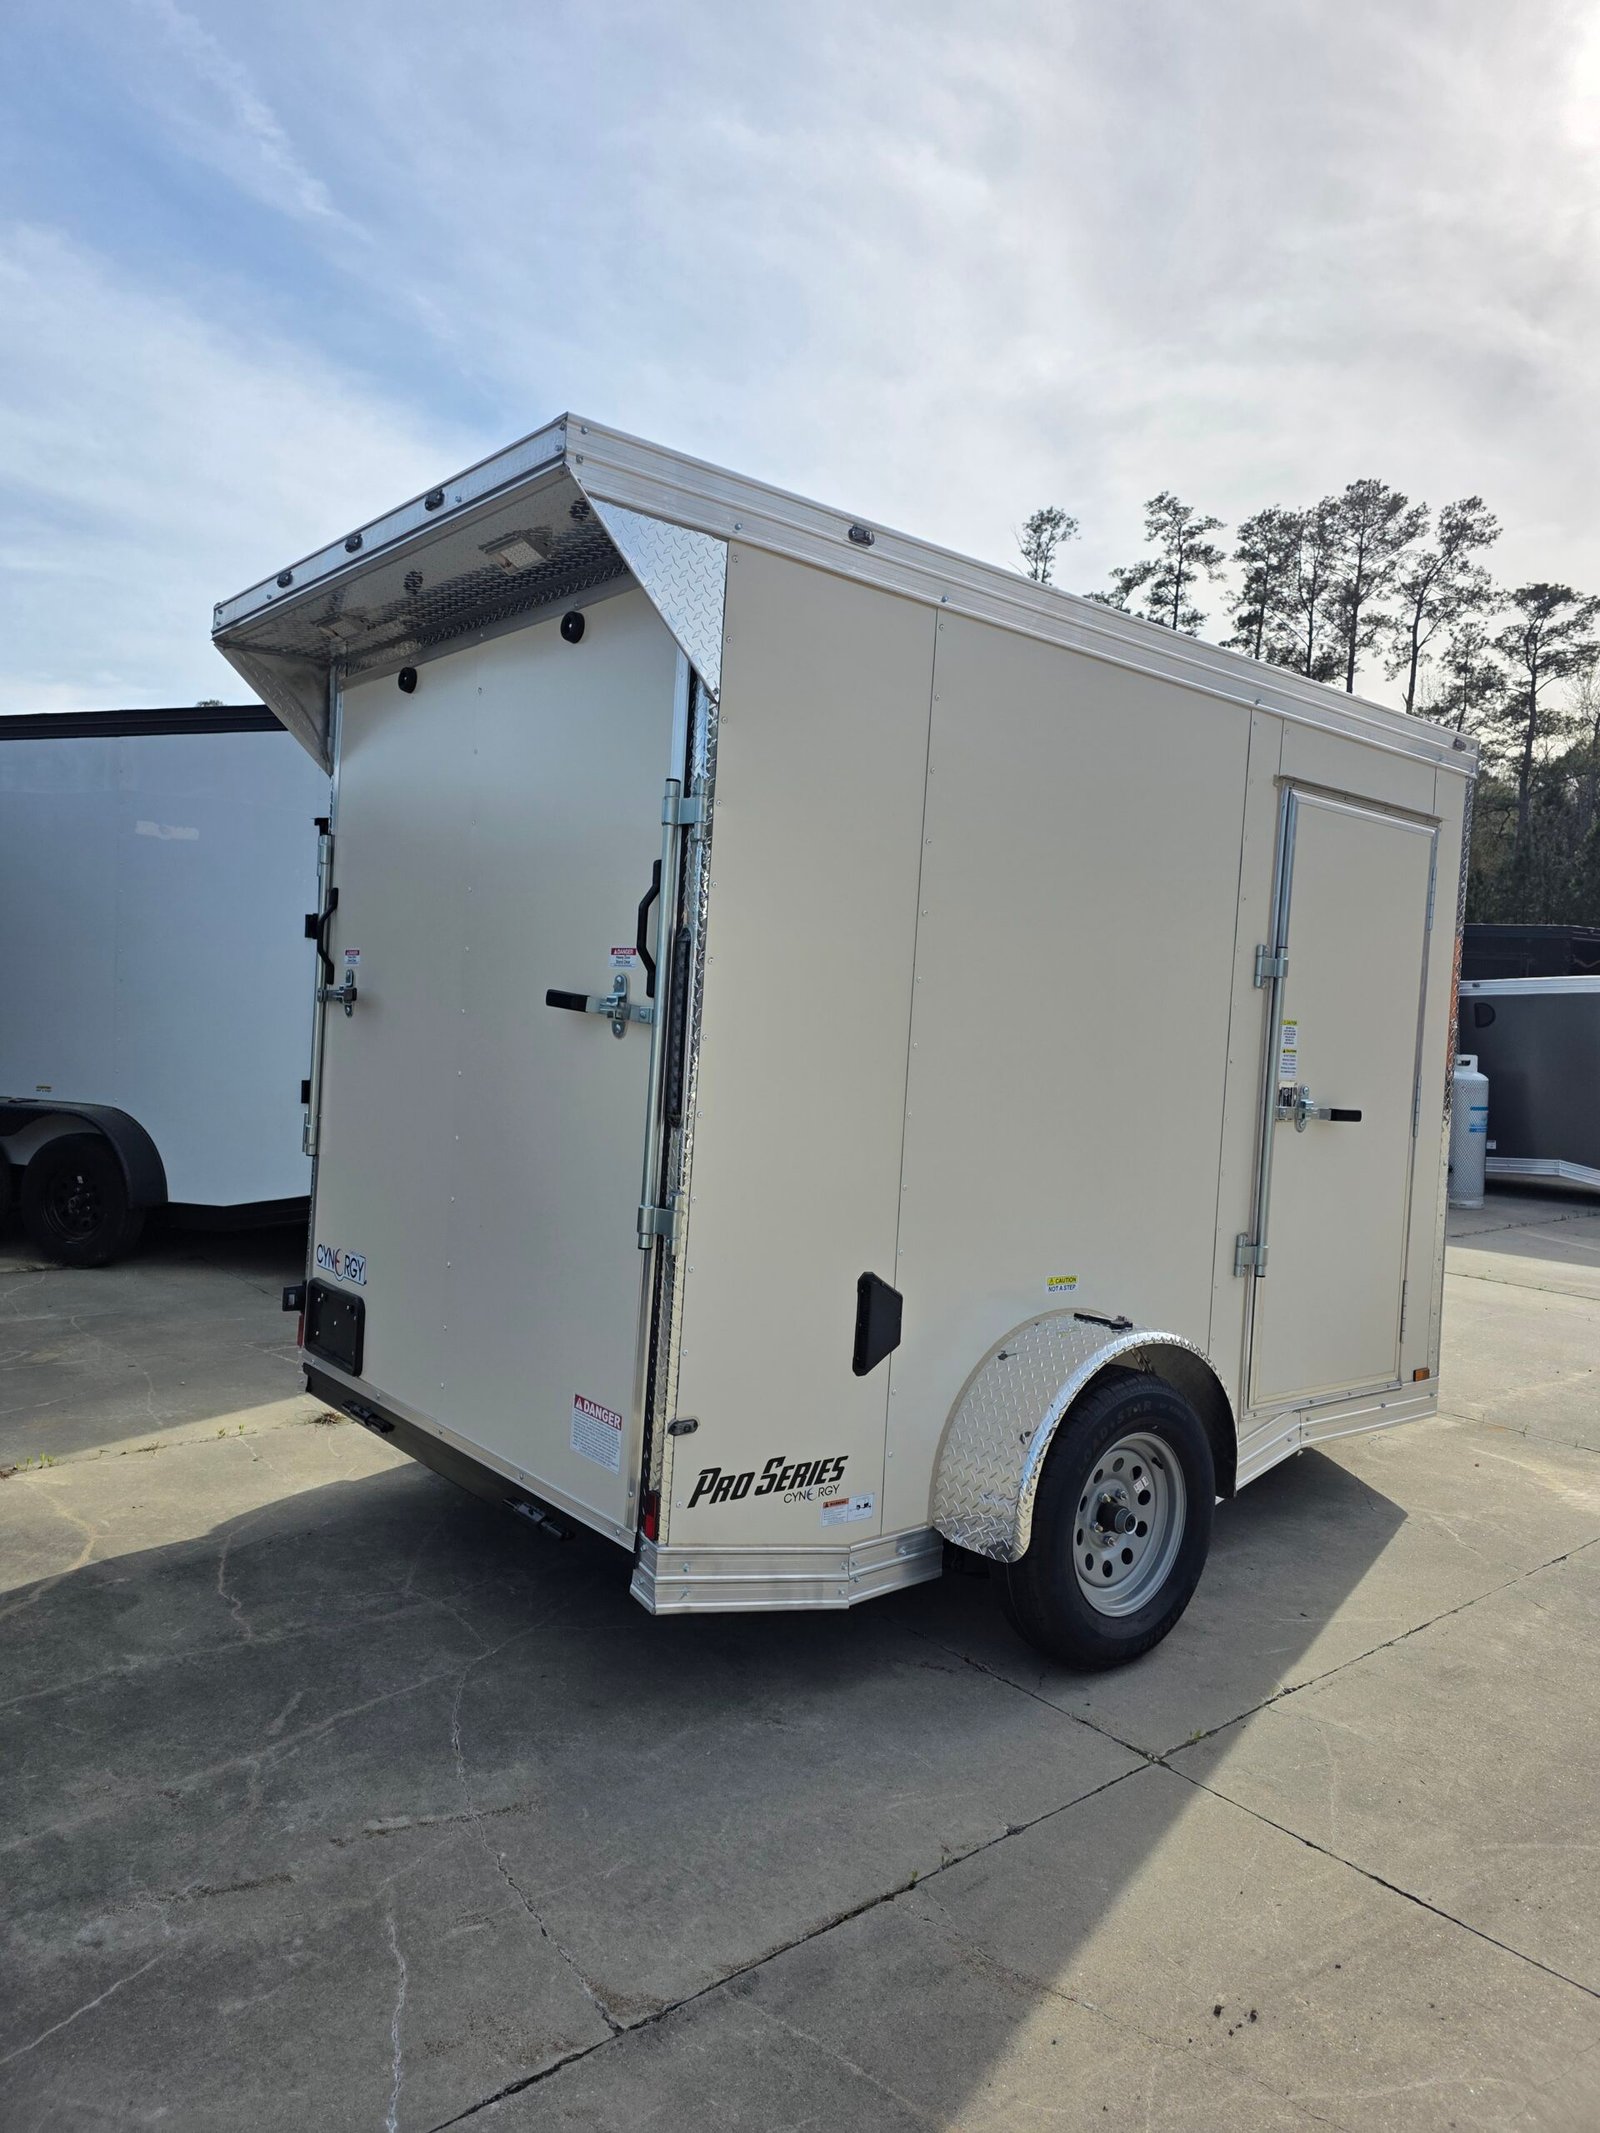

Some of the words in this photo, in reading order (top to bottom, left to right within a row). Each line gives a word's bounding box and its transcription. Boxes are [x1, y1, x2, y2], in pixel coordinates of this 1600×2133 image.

[317, 1244, 365, 1281] CYNERGY
[583, 1400, 621, 1429] DANGER
[783, 1484, 841, 1504] CYNERGY
